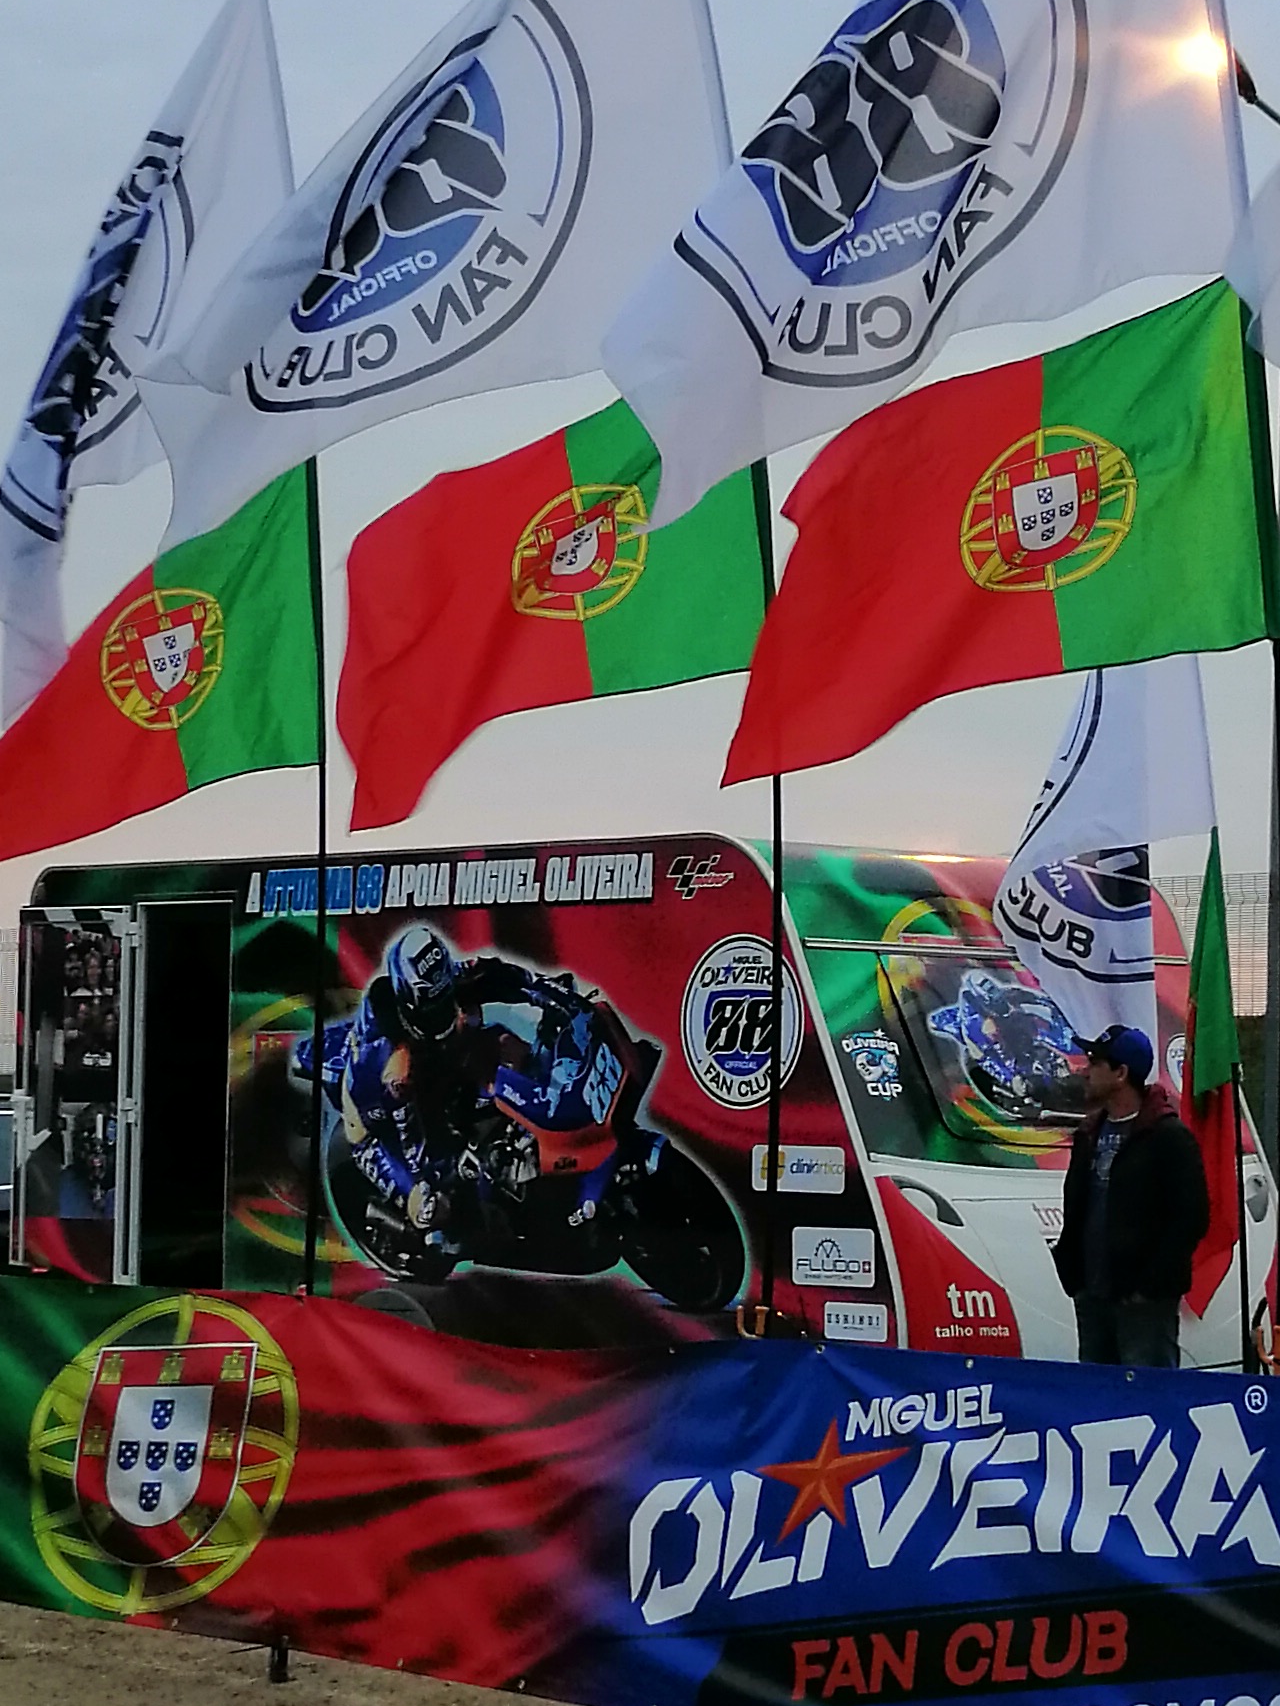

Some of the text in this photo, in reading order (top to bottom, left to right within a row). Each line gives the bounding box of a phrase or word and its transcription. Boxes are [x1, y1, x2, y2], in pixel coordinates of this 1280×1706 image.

[355, 864, 385, 915] 88
[385, 863, 450, 908] APOIA
[453, 858, 540, 905] MIGUEL
[544, 853, 654, 902] OLIVEIRA
[700, 966, 783, 988] OLIVEIR
[732, 955, 762, 965] MIGUEL
[704, 1062, 733, 1096] FAN
[866, 1082, 903, 1098] CUP
[946, 1282, 996, 1318] tm
[935, 1324, 1010, 1338] talho mota
[845, 1384, 1003, 1442] MIGUEL
[791, 1609, 1129, 1701] FAN CLUB
